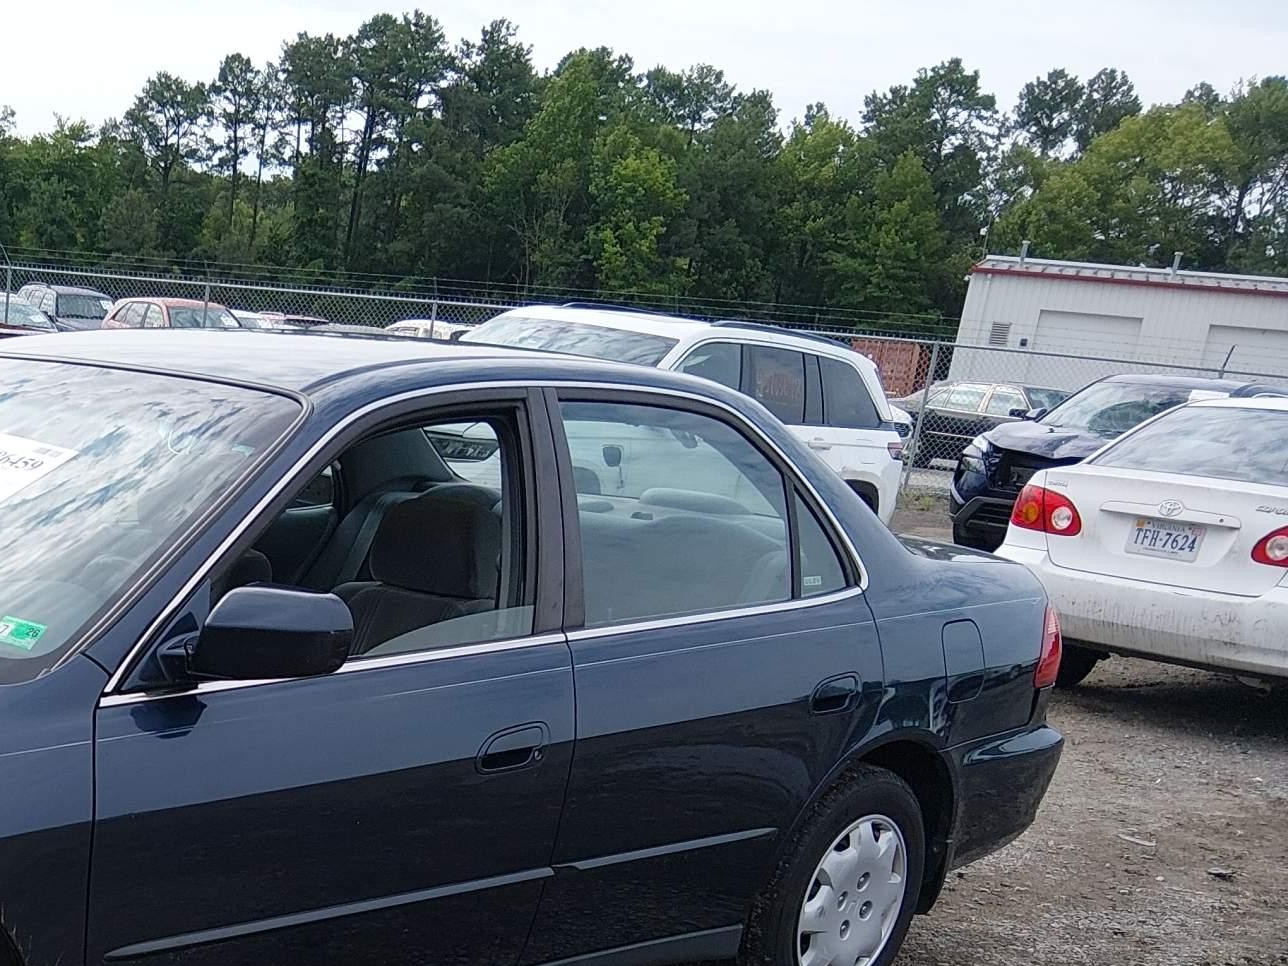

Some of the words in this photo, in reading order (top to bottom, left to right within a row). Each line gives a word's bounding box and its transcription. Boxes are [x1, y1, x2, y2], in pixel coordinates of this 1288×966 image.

[1133, 527, 1198, 553] TFH-7624
[0, 624, 10, 634] 7
[25, 625, 41, 638] 26
